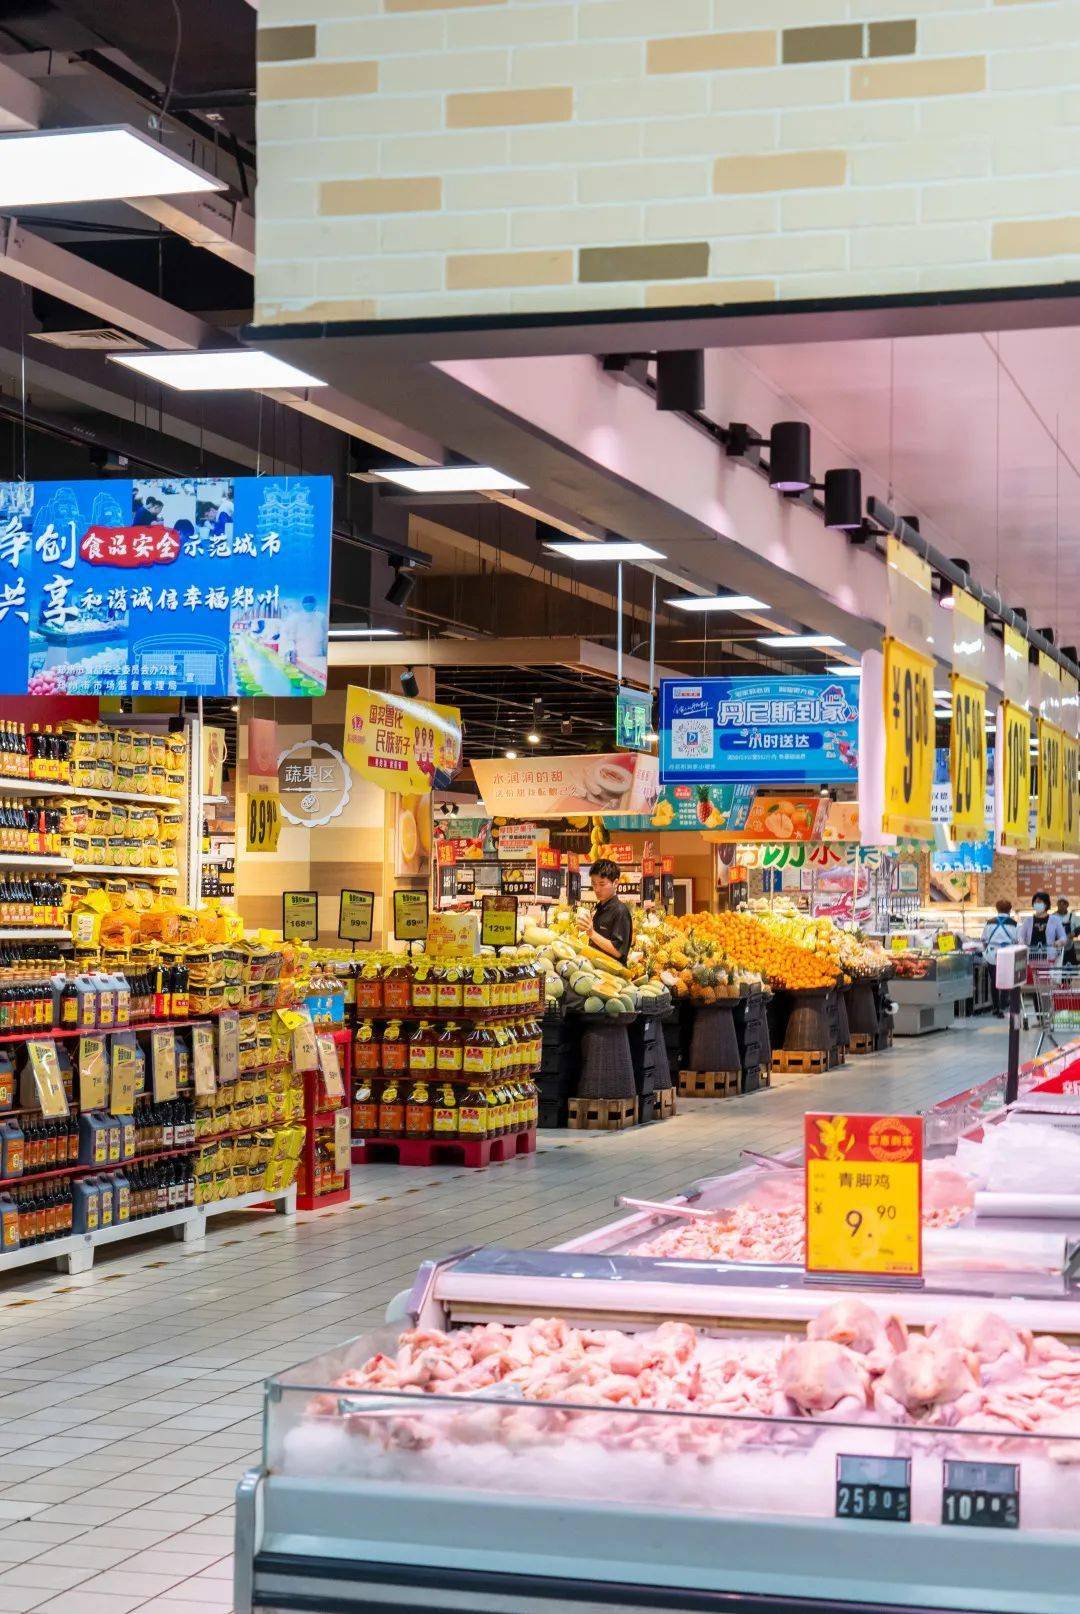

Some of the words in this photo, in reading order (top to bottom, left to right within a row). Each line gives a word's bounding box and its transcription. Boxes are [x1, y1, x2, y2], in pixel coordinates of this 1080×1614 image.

[733, 733, 810, 749] 一小时送达
[285, 764, 336, 784] 蔬果区
[492, 770, 563, 785] 水润润的甜
[839, 1172, 890, 1190] 青脚鸡
